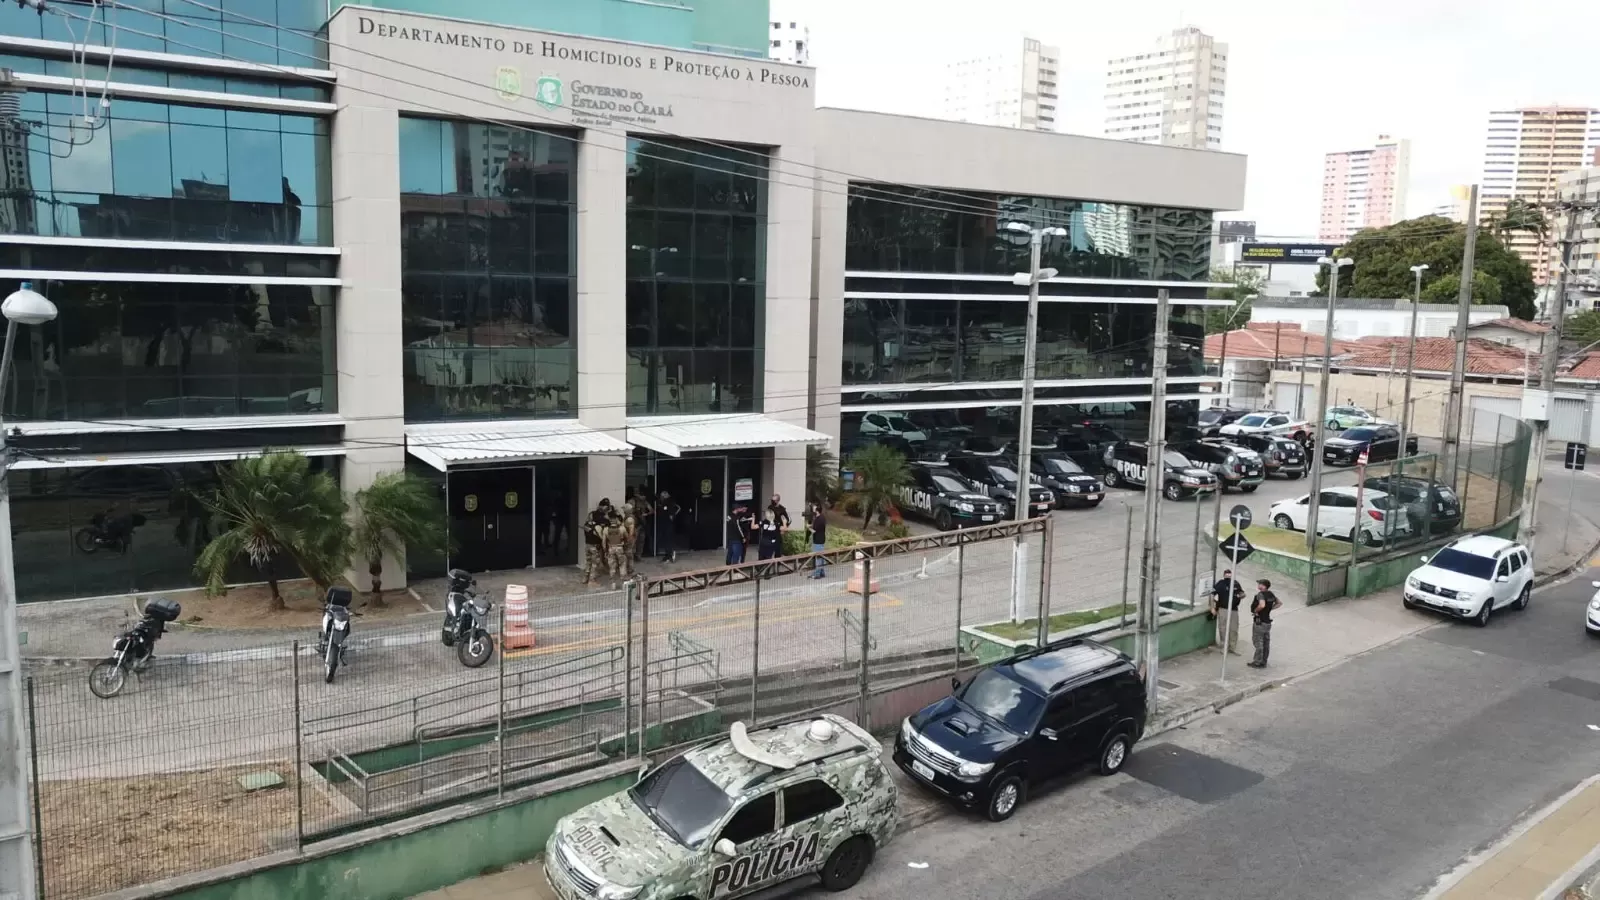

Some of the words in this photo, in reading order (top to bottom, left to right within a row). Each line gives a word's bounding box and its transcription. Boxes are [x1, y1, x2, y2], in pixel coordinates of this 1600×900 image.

[358, 17, 505, 51] DEPARTAMENTO
[513, 41, 534, 55] DE
[541, 40, 642, 68] HOMICÍDIOS
[649, 55, 657, 69] E
[664, 56, 740, 80] PROTEÇÃO
[745, 67, 754, 81] À
[760, 68, 809, 88] PESSOA
[571, 80, 628, 98] GOVERNO
[630, 91, 643, 100] DO
[571, 94, 616, 110] ESTADO
[618, 104, 632, 112] DO
[633, 100, 673, 117] CEARÁ
